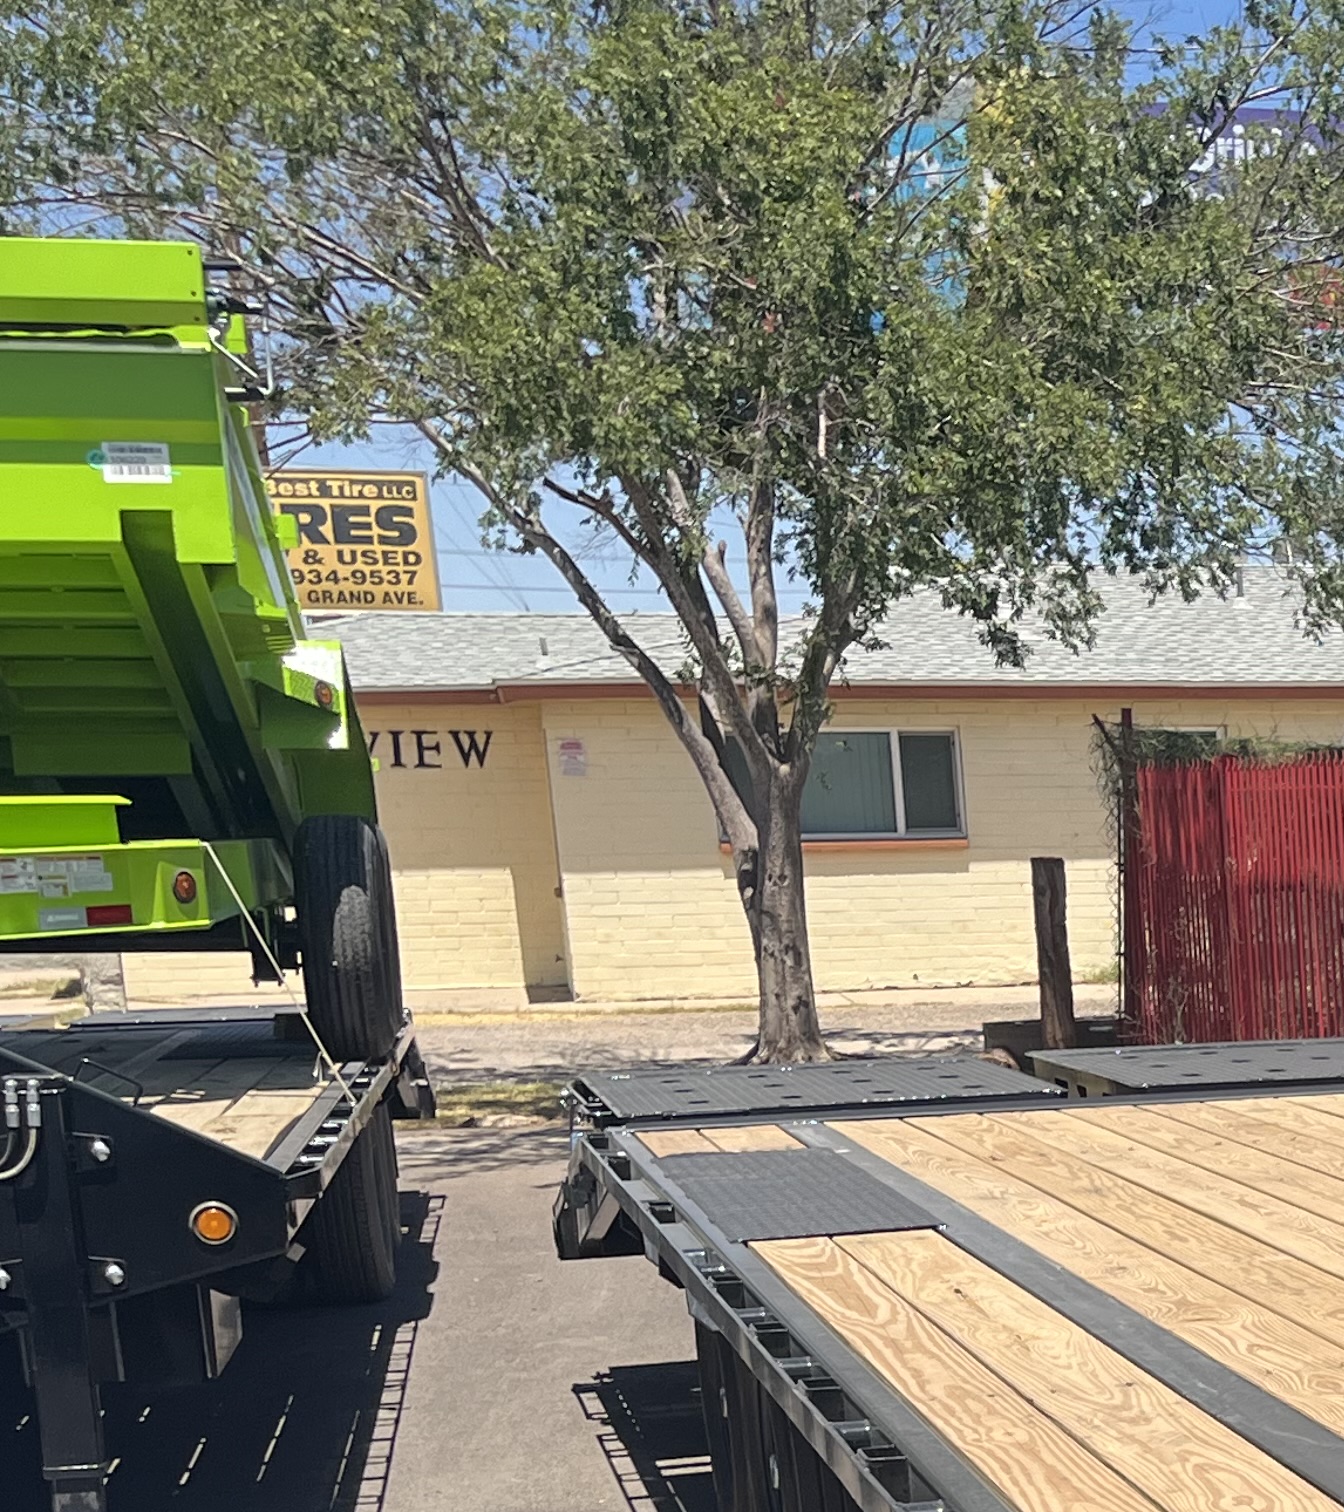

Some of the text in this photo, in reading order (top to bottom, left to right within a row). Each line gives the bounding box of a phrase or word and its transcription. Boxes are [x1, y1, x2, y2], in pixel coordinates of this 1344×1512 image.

[264, 480, 414, 499] Best Tire LLC
[273, 503, 418, 546] RES
[303, 550, 325, 566] &
[337, 550, 422, 567] USED
[292, 569, 418, 586] 934-9537
[307, 590, 424, 605] GRAND AVE.
